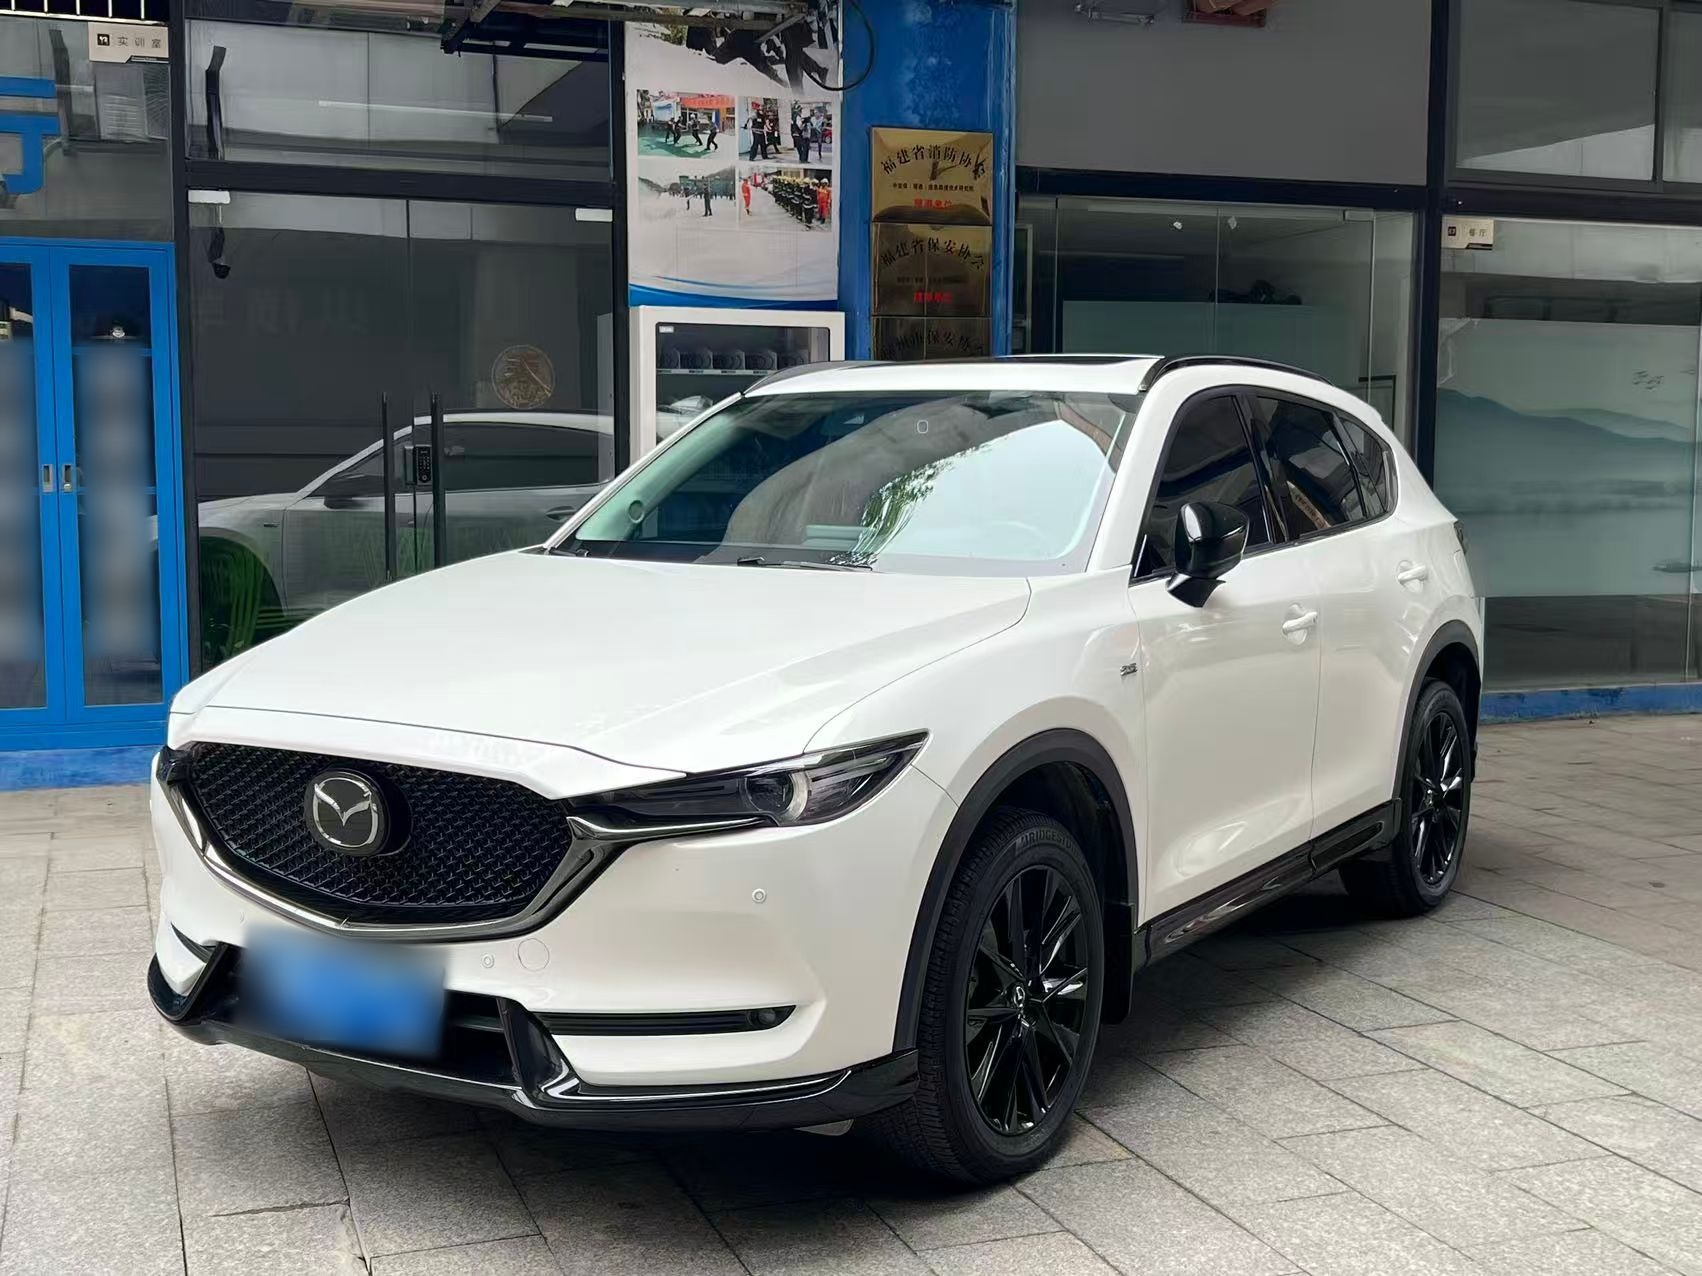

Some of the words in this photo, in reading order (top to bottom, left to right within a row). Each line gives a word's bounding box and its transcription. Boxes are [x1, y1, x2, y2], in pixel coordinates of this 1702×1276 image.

[117, 35, 161, 49] 实训室
[880, 144, 985, 179] 福建省消防协会
[881, 237, 985, 271] 福建省保安协会
